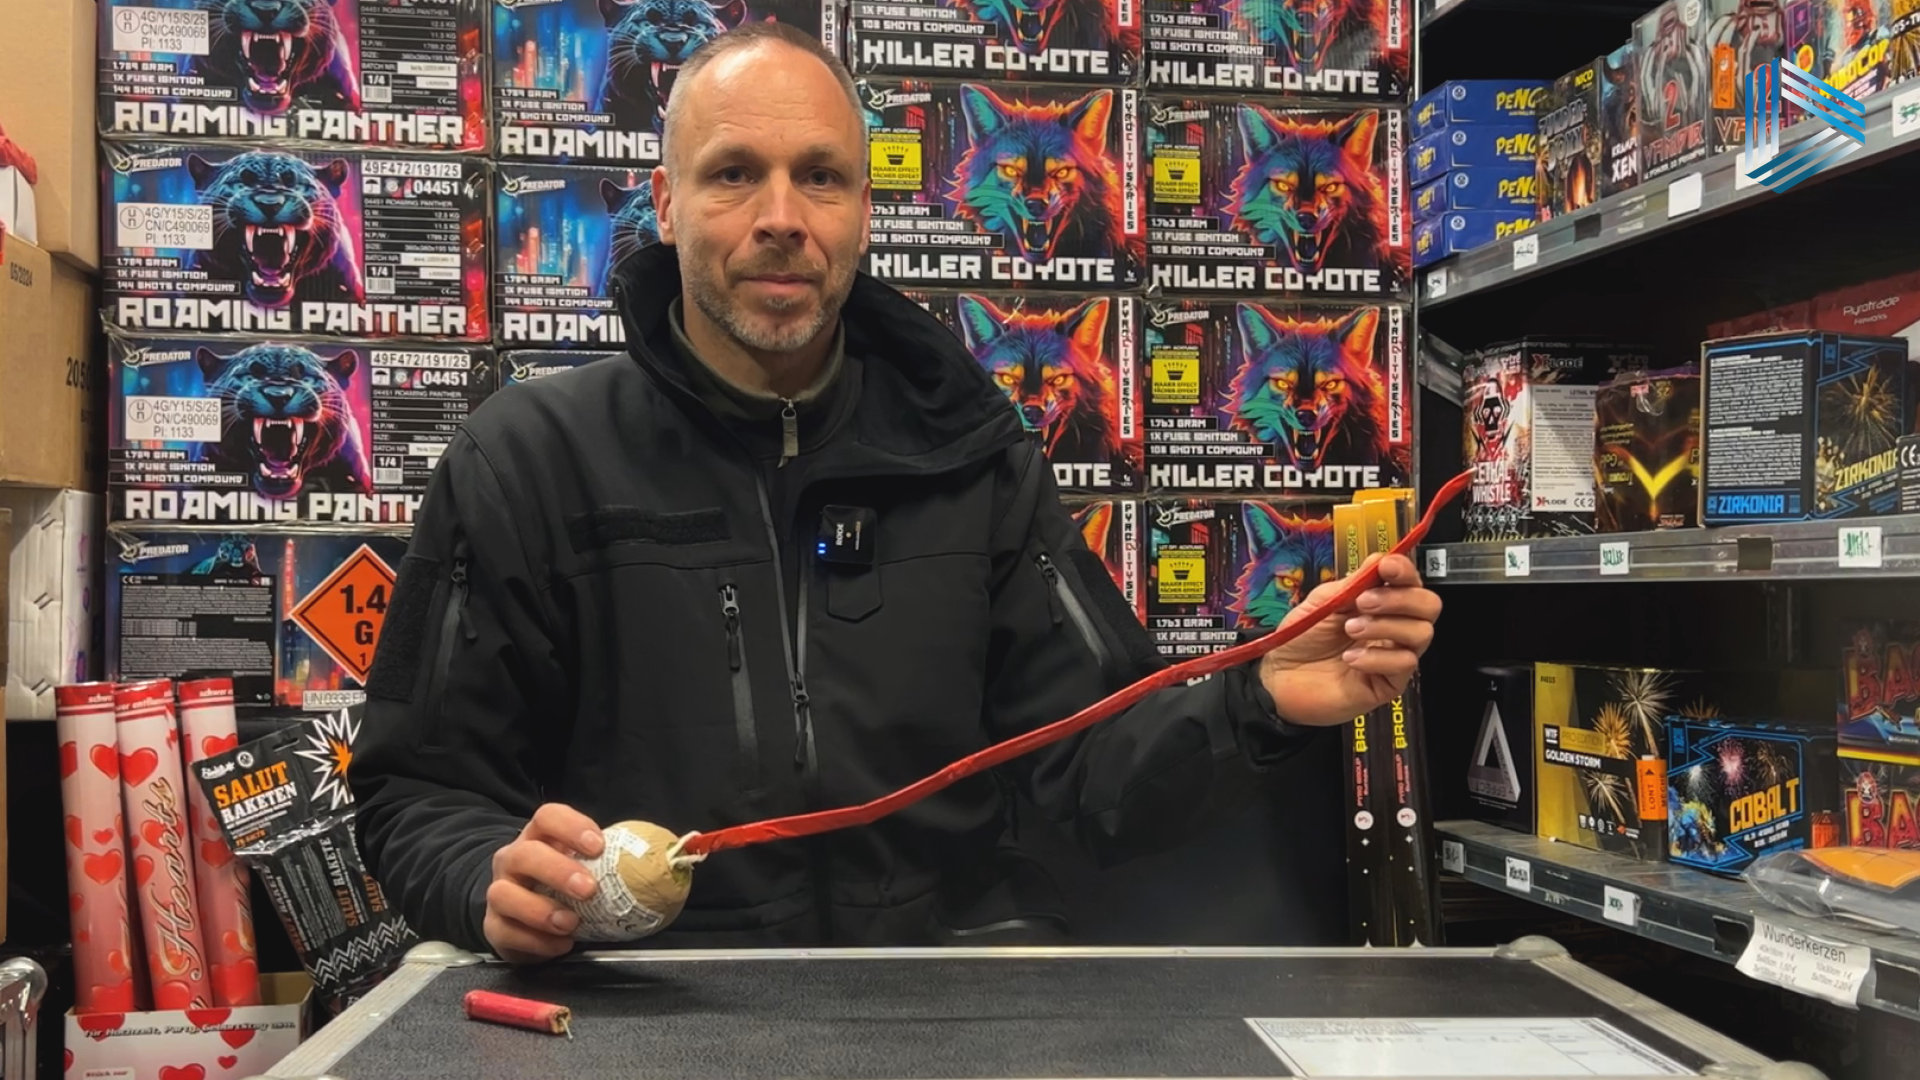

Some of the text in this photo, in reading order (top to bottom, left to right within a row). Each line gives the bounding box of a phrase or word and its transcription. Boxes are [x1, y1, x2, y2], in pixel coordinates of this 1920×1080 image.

[141, 12, 206, 25] 4G/Y15/S/25
[878, 7, 957, 19] FUSE IGNITION
[1177, 15, 1206, 25] GRAM
[141, 25, 206, 38] CN/C490069
[885, 20, 985, 33] SHOTS COMPOUND
[1164, 28, 1238, 41] FUSE IGNITION
[159, 39, 182, 50] 1133
[1170, 43, 1264, 55] SHOTS COMPOUND
[863, 39, 1109, 74] KILLER COYOTE
[127, 74, 155, 83] FUSE
[368, 74, 387, 85] 1/4
[1150, 61, 1379, 94] KILLER COYOTE
[133, 86, 168, 95] SHOTS
[172, 88, 232, 98] COMPOUND
[515, 101, 540, 109] FUSE
[115, 102, 463, 144] ROAMING PANTHER
[521, 112, 611, 123] SHOTS COMPOUND
[501, 126, 660, 160] ROAMING
[133, 157, 182, 168] PREDATOR
[1612, 151, 1638, 183] XEN
[365, 161, 459, 177] 49F472/191/25
[414, 179, 459, 196] 04451
[520, 180, 565, 192] PREDATOR
[145, 208, 210, 222] 4G/Y15/S/25
[900, 205, 929, 216] GRAM
[145, 221, 210, 234] CN/C490069
[885, 219, 963, 231] FUSE IGNITION
[1178, 219, 1207, 228] GRAM
[163, 234, 186, 245] 1133
[891, 234, 991, 245] SHOTS COMPOUND
[1165, 233, 1191, 241] FUSE
[1171, 246, 1264, 256] SHOTS COMPOUND
[371, 266, 389, 278] 1/4
[871, 253, 1115, 282] KILLER COYOTE
[131, 270, 158, 279] FUSE
[1152, 264, 1380, 292] KILLER COYOTE
[138, 282, 172, 291] SHOTS
[176, 283, 235, 293] COMPOUND
[518, 287, 543, 295] FUSE
[524, 298, 614, 308] SHOTS COMPOUND
[119, 297, 466, 335] ROAMING PANTHER
[504, 312, 626, 342] ROAMI
[373, 352, 468, 368] 49F472/191/25
[422, 369, 468, 387] 04451
[153, 401, 220, 414] 4G/Y15/S/25
[153, 412, 220, 426] CN/C490069
[1178, 418, 1206, 428] GRAM
[172, 426, 195, 438] 1133
[1164, 432, 1190, 440] FUSE
[1170, 445, 1264, 455] SHOTS COMPOUND
[139, 463, 166, 471] FUSE
[379, 456, 397, 468] 1/4
[145, 474, 180, 483] SHOTS
[184, 475, 243, 483] COMPOUND
[1151, 464, 1380, 488] KILLER COYOTE
[126, 490, 425, 522] ROAMING PANTH
[1718, 494, 1785, 514] ZIRKONIA
[1175, 510, 1214, 522] PREDATOR
[340, 584, 386, 614] 1.4
[1183, 618, 1212, 628] GRAM
[355, 620, 374, 646] G
[1169, 632, 1237, 641] FUSE IGNITIO
[1176, 645, 1210, 653] SHOTS
[360, 652, 368, 666] 1
[1545, 749, 1601, 769] GOLDEN STORM
[214, 761, 290, 809] SALUT
[221, 781, 298, 825] RAKETEN
[1730, 777, 1799, 834] COBALT
[321, 837, 347, 887] RAKETE
[336, 885, 360, 928] SALUT
[1762, 922, 1846, 963] Wunderkerzen
